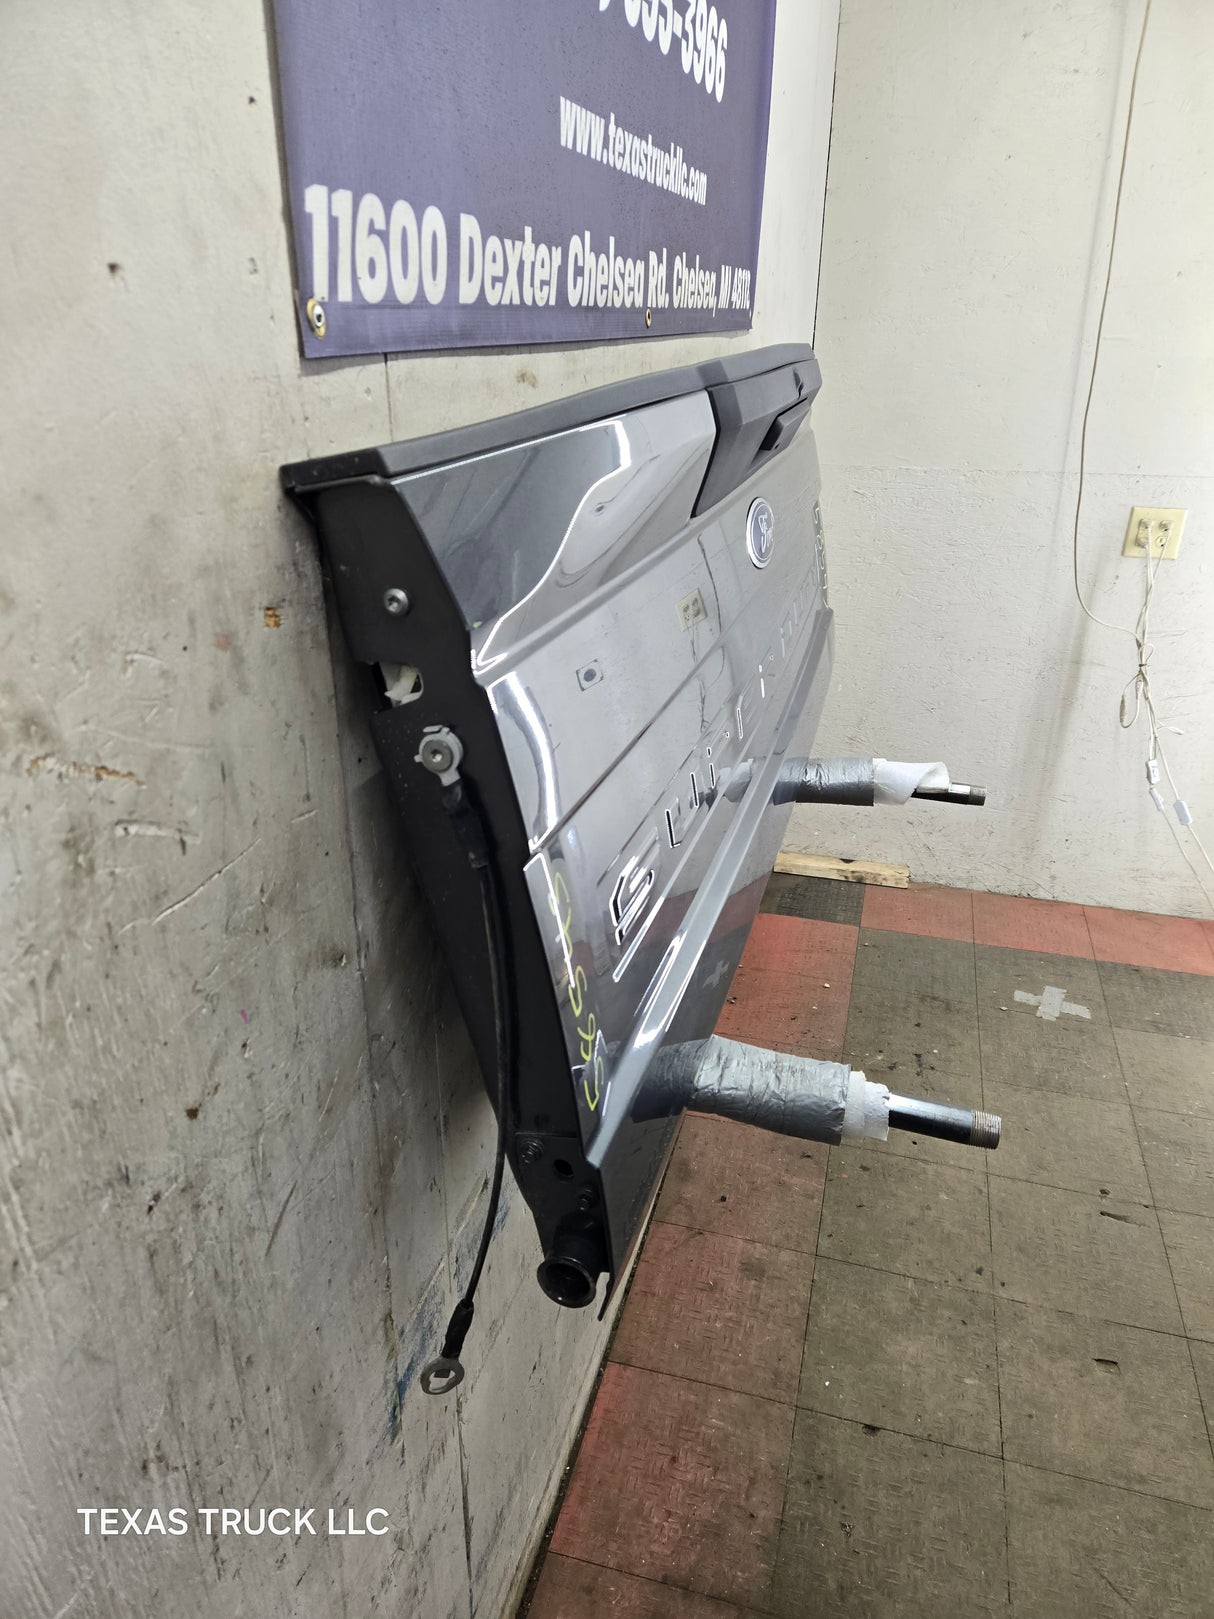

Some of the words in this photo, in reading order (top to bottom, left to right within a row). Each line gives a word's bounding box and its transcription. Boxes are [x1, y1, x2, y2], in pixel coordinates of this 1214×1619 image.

[560, 95, 708, 205] www.texastruckllc.com
[304, 183, 448, 305] 11600
[459, 212, 562, 307] Dexter
[567, 230, 645, 308] Chelsea
[646, 247, 670, 309] Rd.
[672, 251, 717, 318] Chelsea,
[717, 264, 732, 309] MI
[731, 267, 751, 310] 48118
